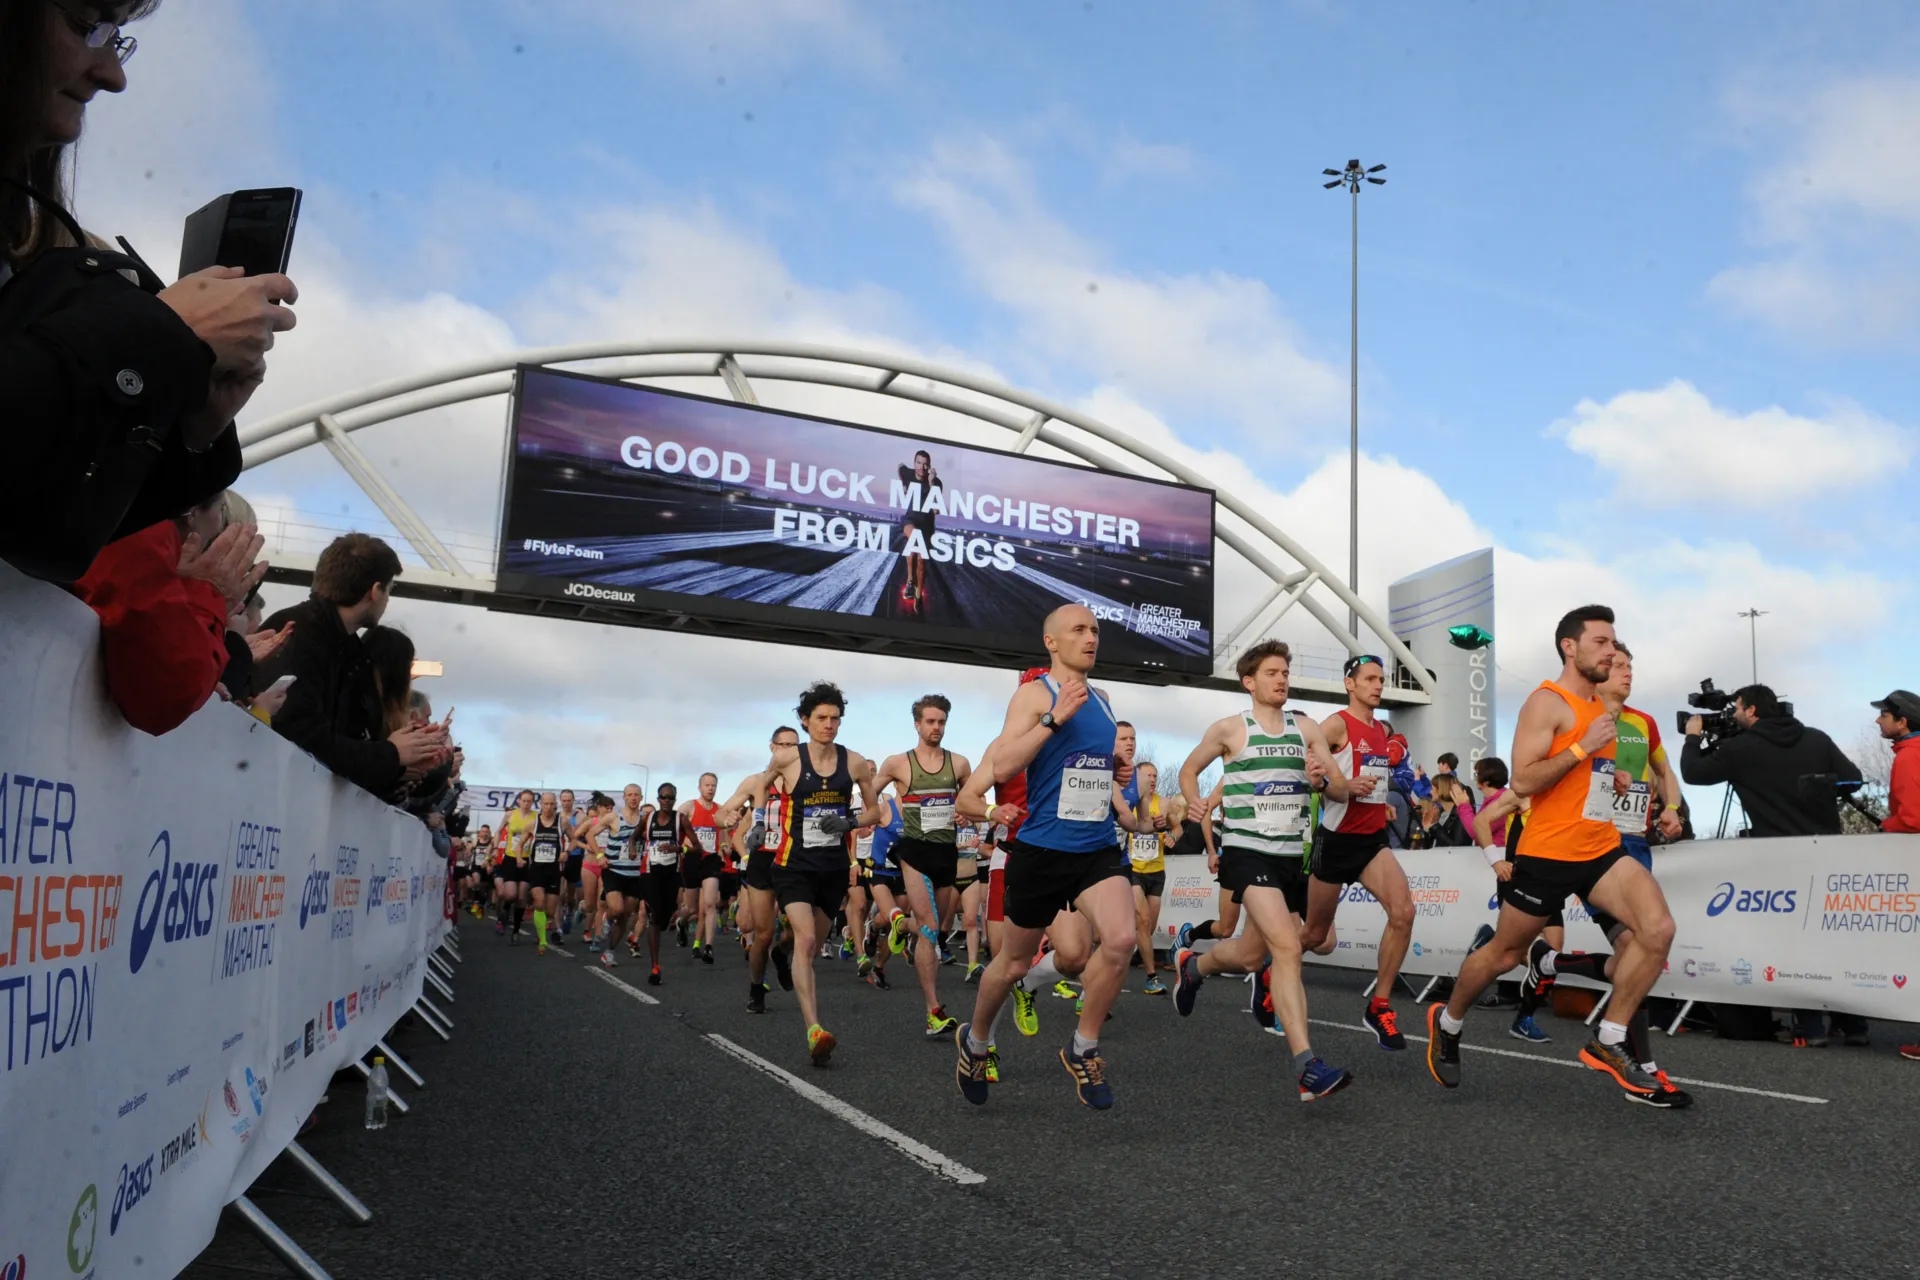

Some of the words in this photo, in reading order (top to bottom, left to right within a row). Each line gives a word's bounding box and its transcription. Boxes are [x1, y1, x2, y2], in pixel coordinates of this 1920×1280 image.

[621, 435, 750, 483] GOOD
[765, 458, 875, 504] LUCK
[889, 479, 1140, 547] MANCHESTER
[773, 507, 890, 552] FROM
[902, 529, 1016, 572] ASICS
[523, 538, 604, 560] #FlyteFoam
[564, 582, 636, 603] JCDecaux
[1140, 603, 1181, 618] GREATER
[1137, 613, 1201, 631] MANCHESTER
[1136, 623, 1189, 639] MARATHON
[1256, 746, 1304, 757] TIPTON
[1068, 776, 1110, 790] Charles
[812, 791, 839, 799] LONDON
[1257, 802, 1300, 812] Williams
[1612, 793, 1648, 813] 2618
[1134, 840, 1157, 850] 4150
[1174, 876, 1201, 887] GREATER
[1827, 873, 1909, 892] GREATER
[1171, 887, 1213, 898] MANCHESTER
[1170, 897, 1204, 909] MARATHON
[1778, 971, 1792, 979] Save
[1804, 973, 1833, 982] Children
[1844, 971, 1858, 981] The
[1859, 972, 1888, 982] Christie
[159, 1136, 181, 1176] XTRA
